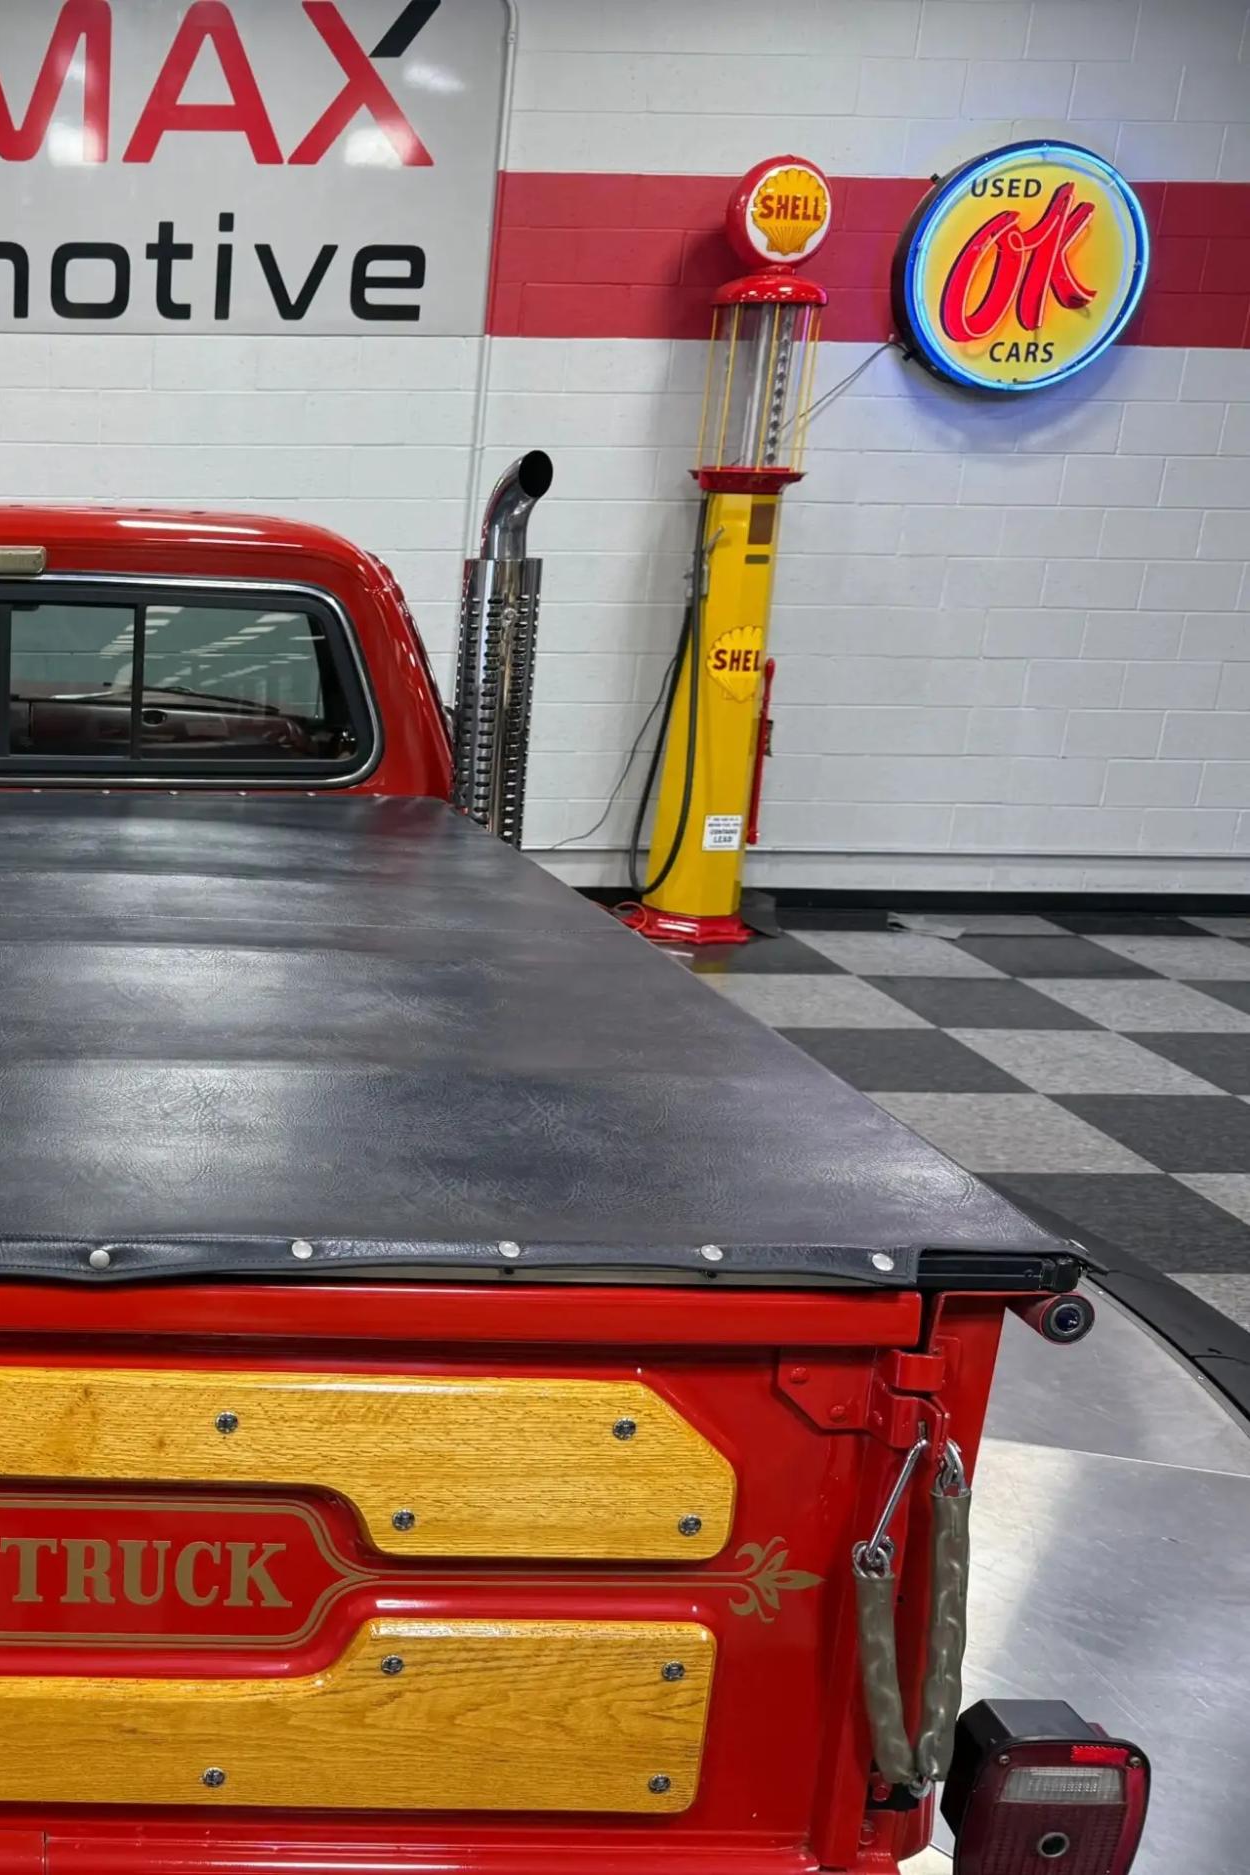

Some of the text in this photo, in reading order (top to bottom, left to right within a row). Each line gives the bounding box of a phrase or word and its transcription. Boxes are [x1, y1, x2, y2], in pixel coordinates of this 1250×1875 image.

[971, 178, 1042, 198] USED
[759, 194, 821, 221] SHELL
[939, 182, 1098, 343] OK
[989, 342, 1054, 363] CARS
[0, 1536, 293, 1608] TRUCK
